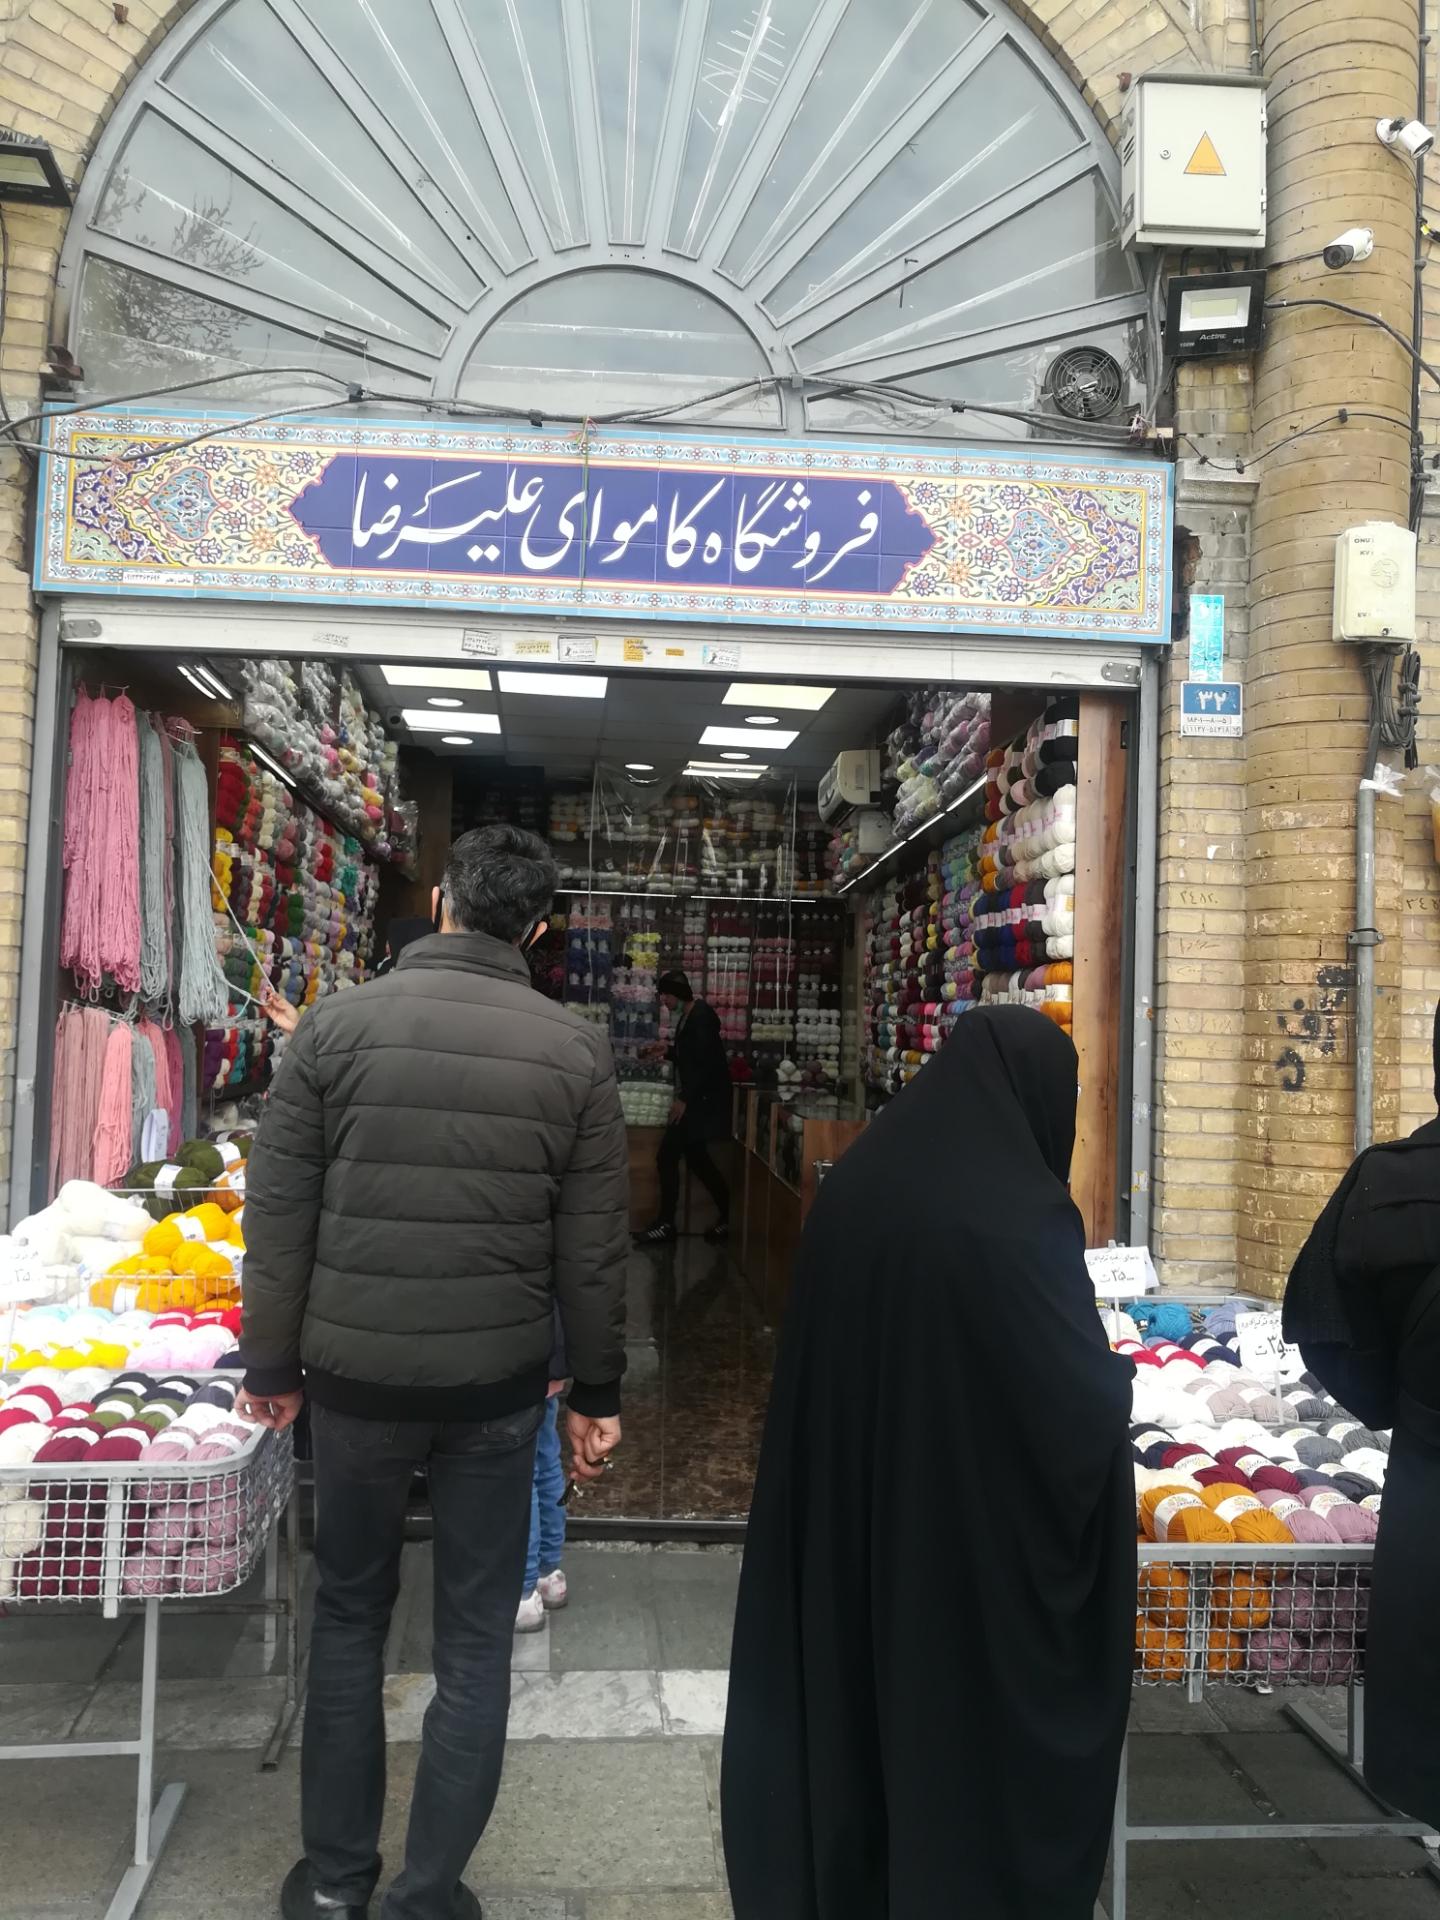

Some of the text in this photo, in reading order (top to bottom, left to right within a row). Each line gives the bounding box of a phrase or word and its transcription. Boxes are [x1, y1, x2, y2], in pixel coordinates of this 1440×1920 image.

[352, 466, 879, 584] فروشگاه کاموای علیرضا
[1198, 690, 1227, 712] ۳۲
